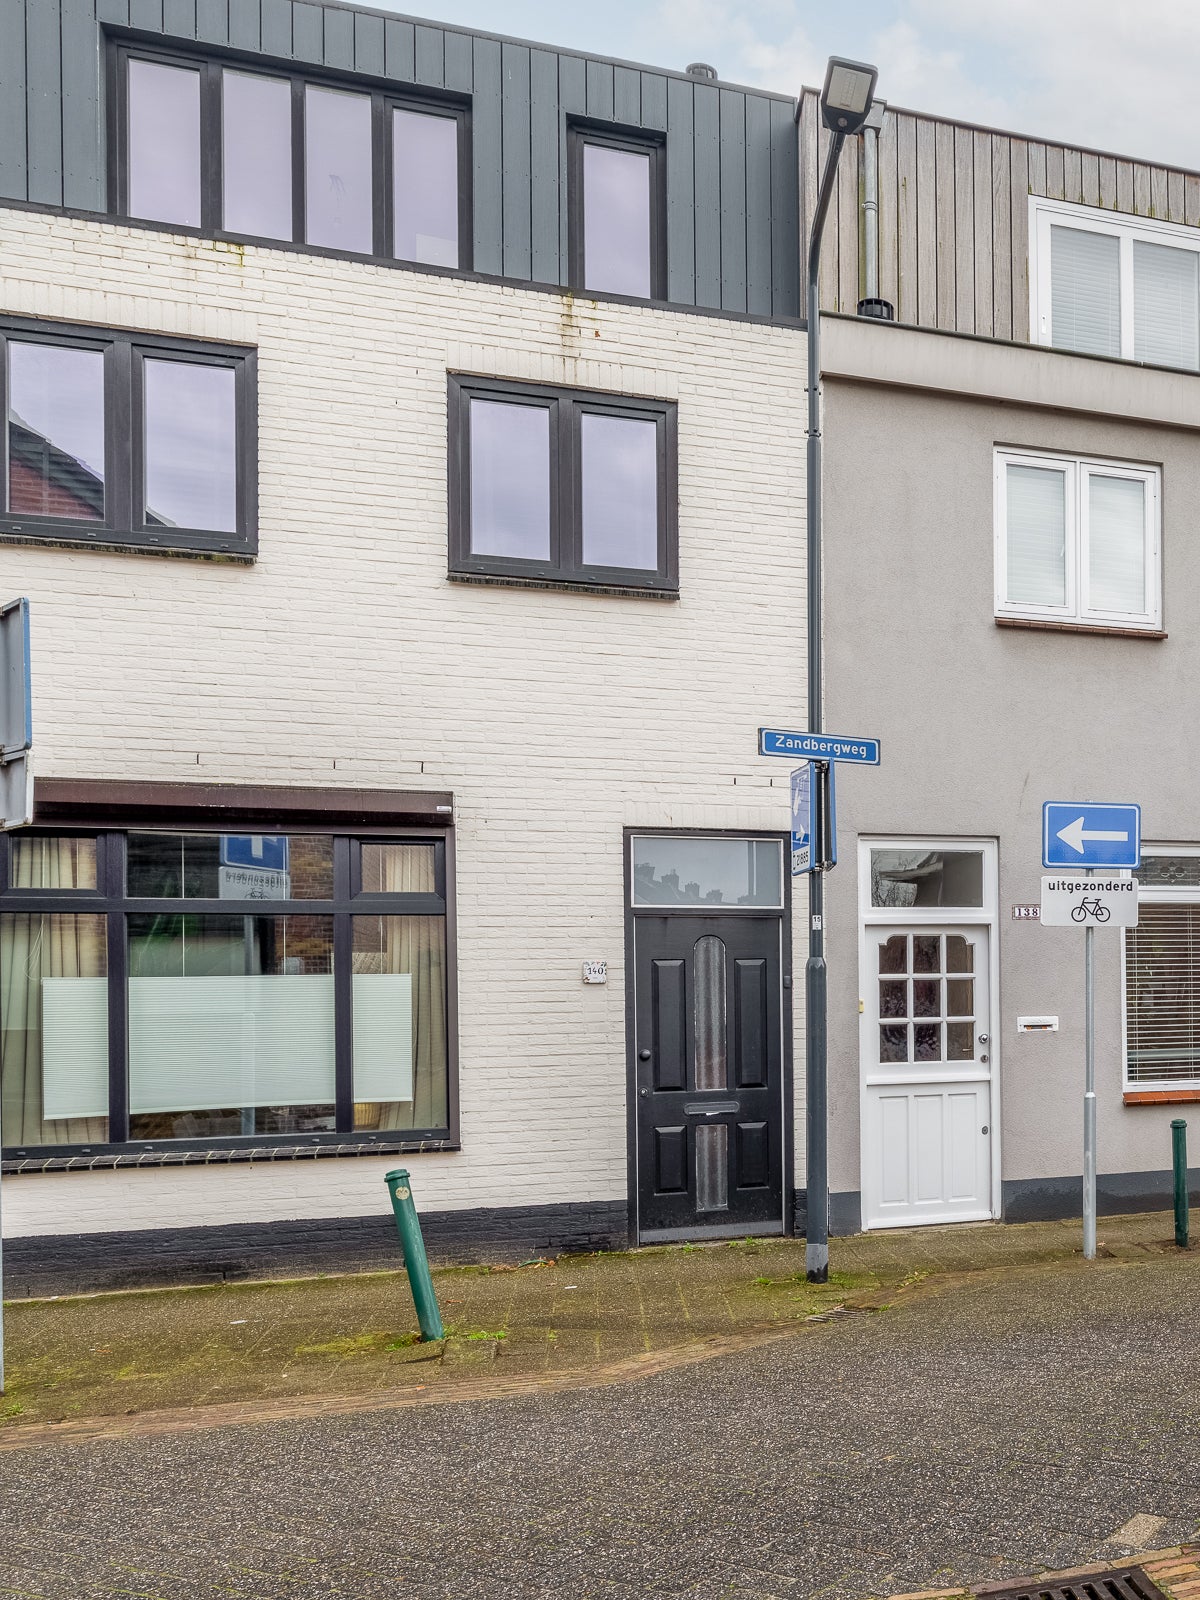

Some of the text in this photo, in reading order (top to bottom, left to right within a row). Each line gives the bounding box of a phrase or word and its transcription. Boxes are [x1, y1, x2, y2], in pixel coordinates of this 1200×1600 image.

[775, 735, 867, 758] Zandbergweg
[1048, 881, 1133, 894] uitgezonderd
[1017, 908, 1039, 917] 138
[587, 967, 604, 975] 140
